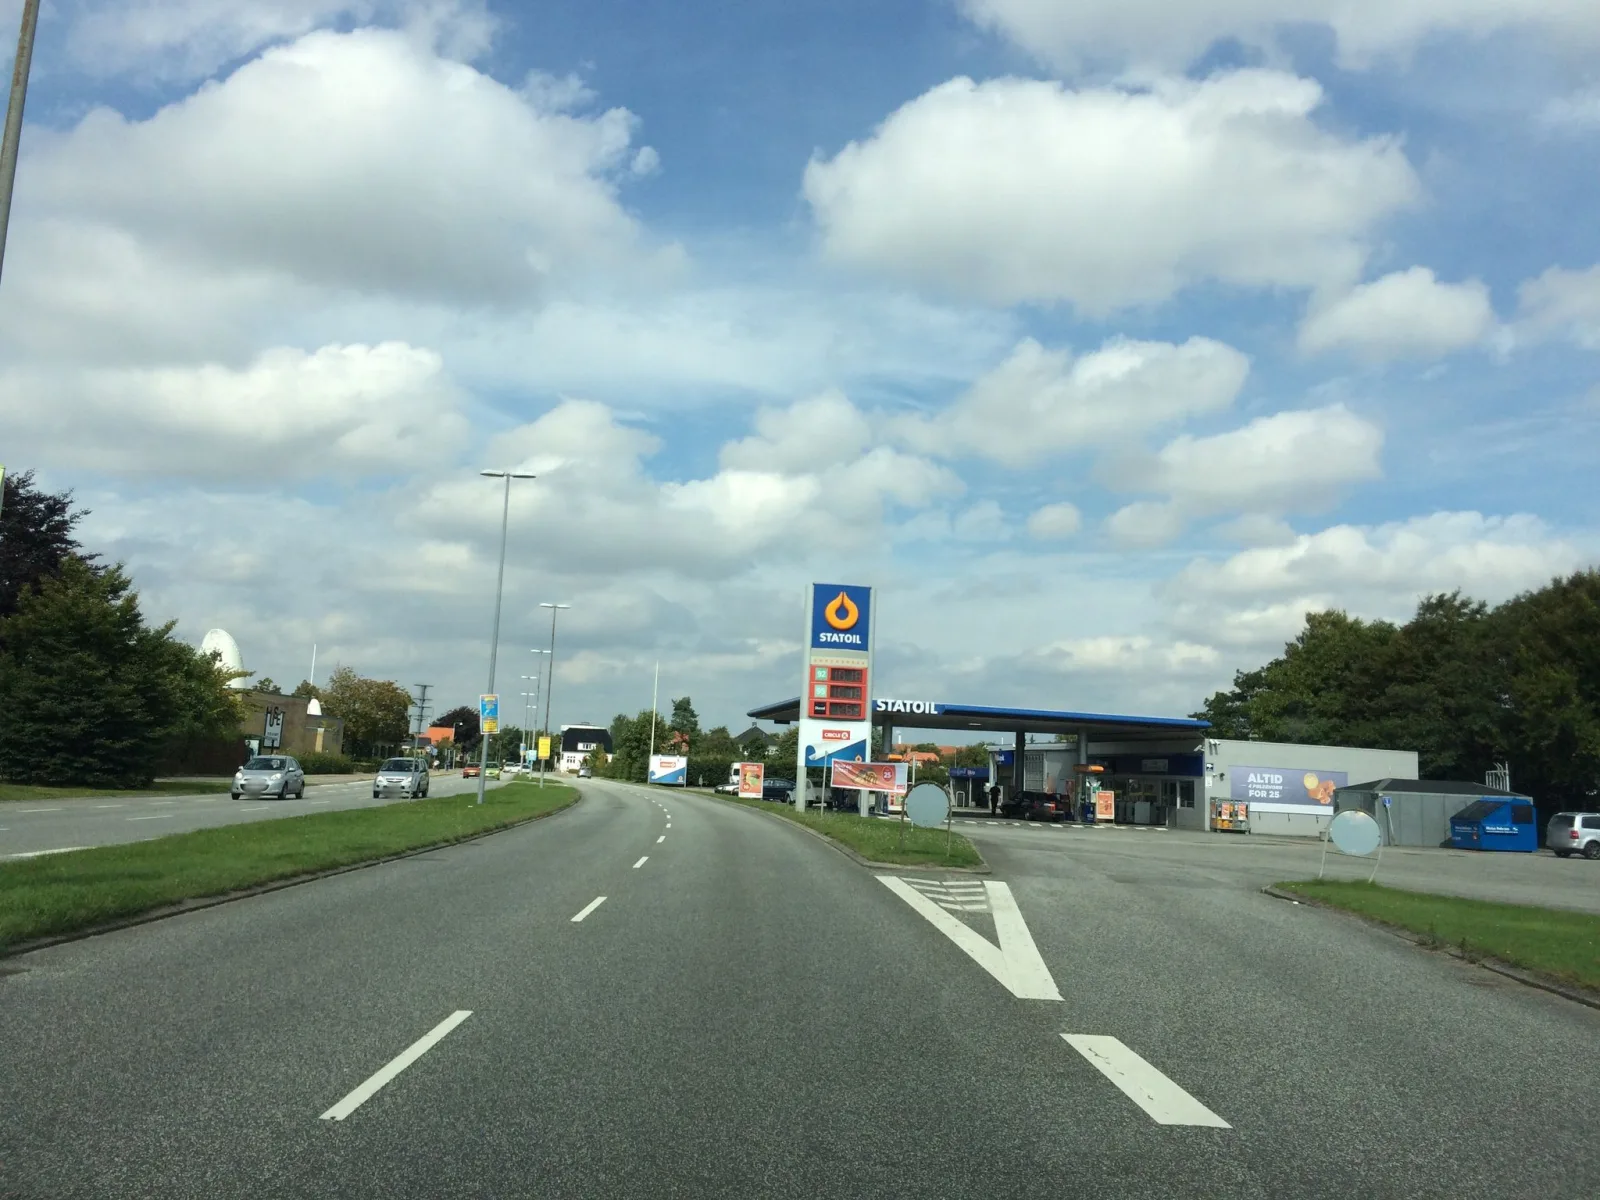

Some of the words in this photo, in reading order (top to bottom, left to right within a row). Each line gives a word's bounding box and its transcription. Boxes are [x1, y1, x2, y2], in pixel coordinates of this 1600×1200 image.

[819, 632, 862, 644] STATOIL
[816, 670, 827, 678] 92
[876, 699, 938, 714] STATOIL
[1247, 773, 1283, 784] ALTID
[1248, 789, 1267, 797] FOR
